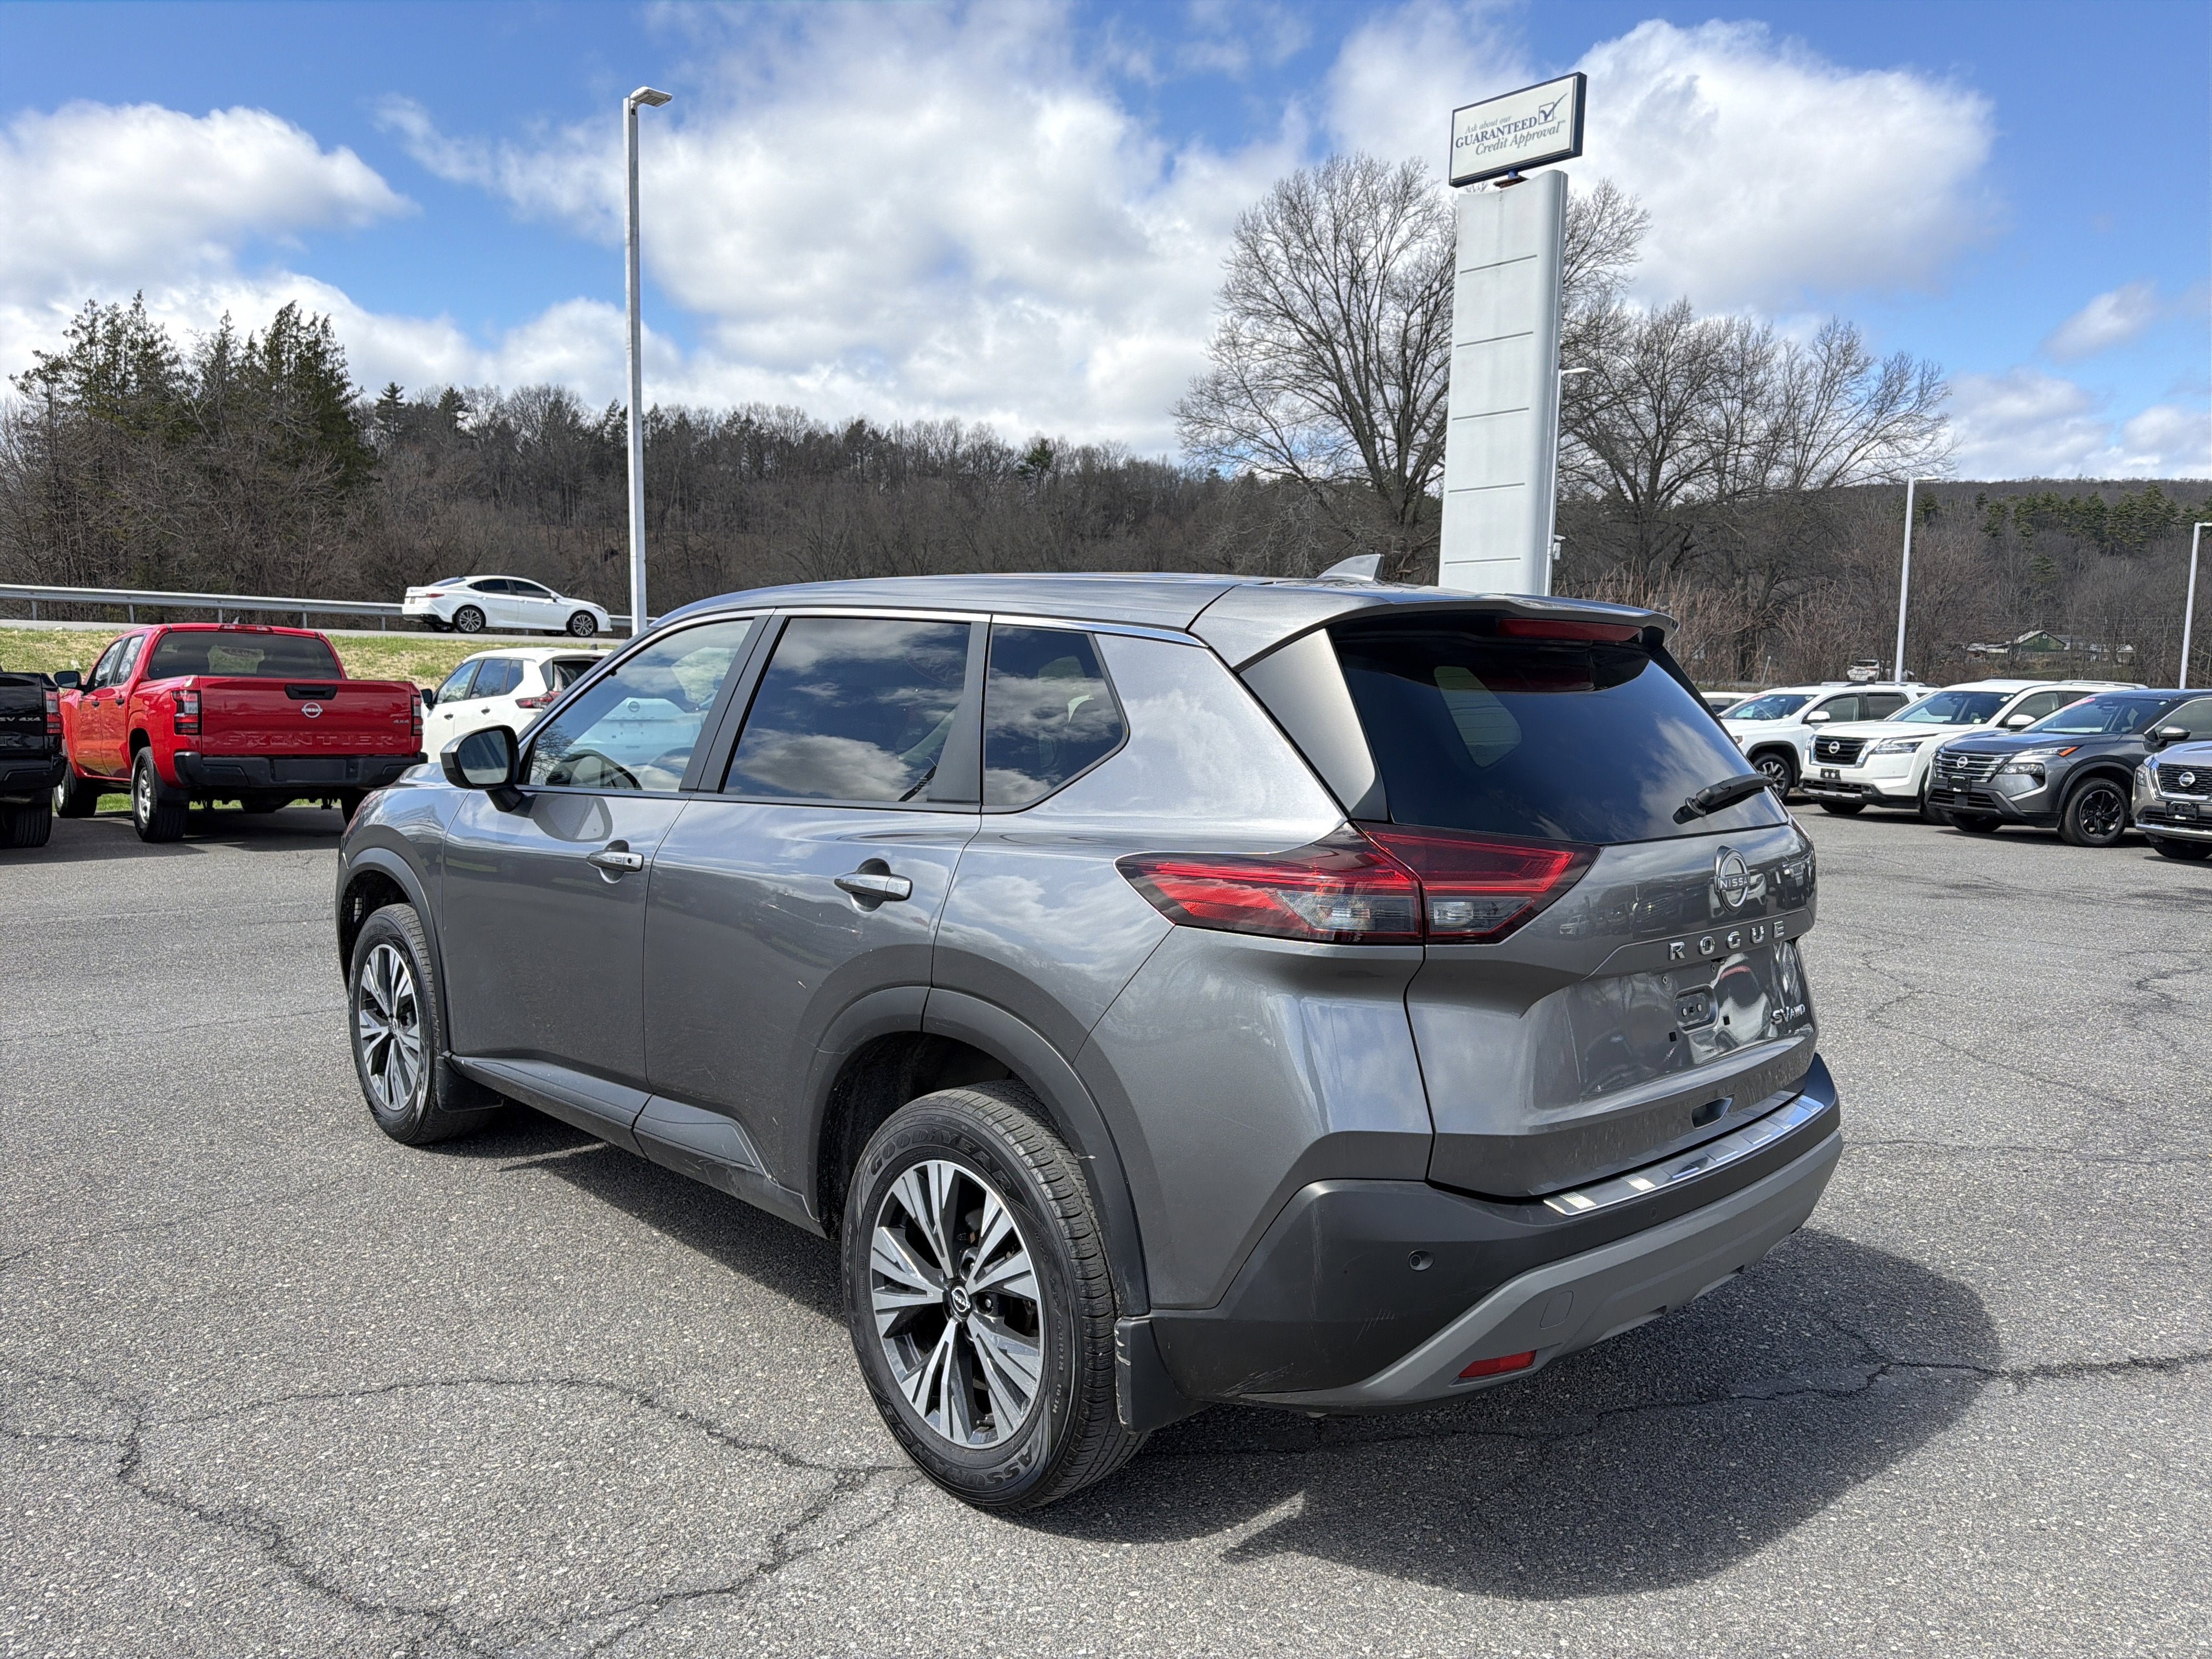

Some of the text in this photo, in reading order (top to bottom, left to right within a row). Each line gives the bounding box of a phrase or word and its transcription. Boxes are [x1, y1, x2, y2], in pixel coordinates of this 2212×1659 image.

[1455, 116, 1537, 149] GUARANTEED
[1465, 115, 1513, 134] Ask about our
[1475, 121, 1561, 155] Credit Approval
[222, 732, 396, 746] FRONTIER
[1719, 876, 1750, 889] NISSA
[1668, 921, 1785, 961] ROGUE
[1770, 1003, 1805, 1025] SV AWD
[870, 1127, 1012, 1191] GOODYEAR
[881, 1403, 1032, 1488] ASSURANCE
